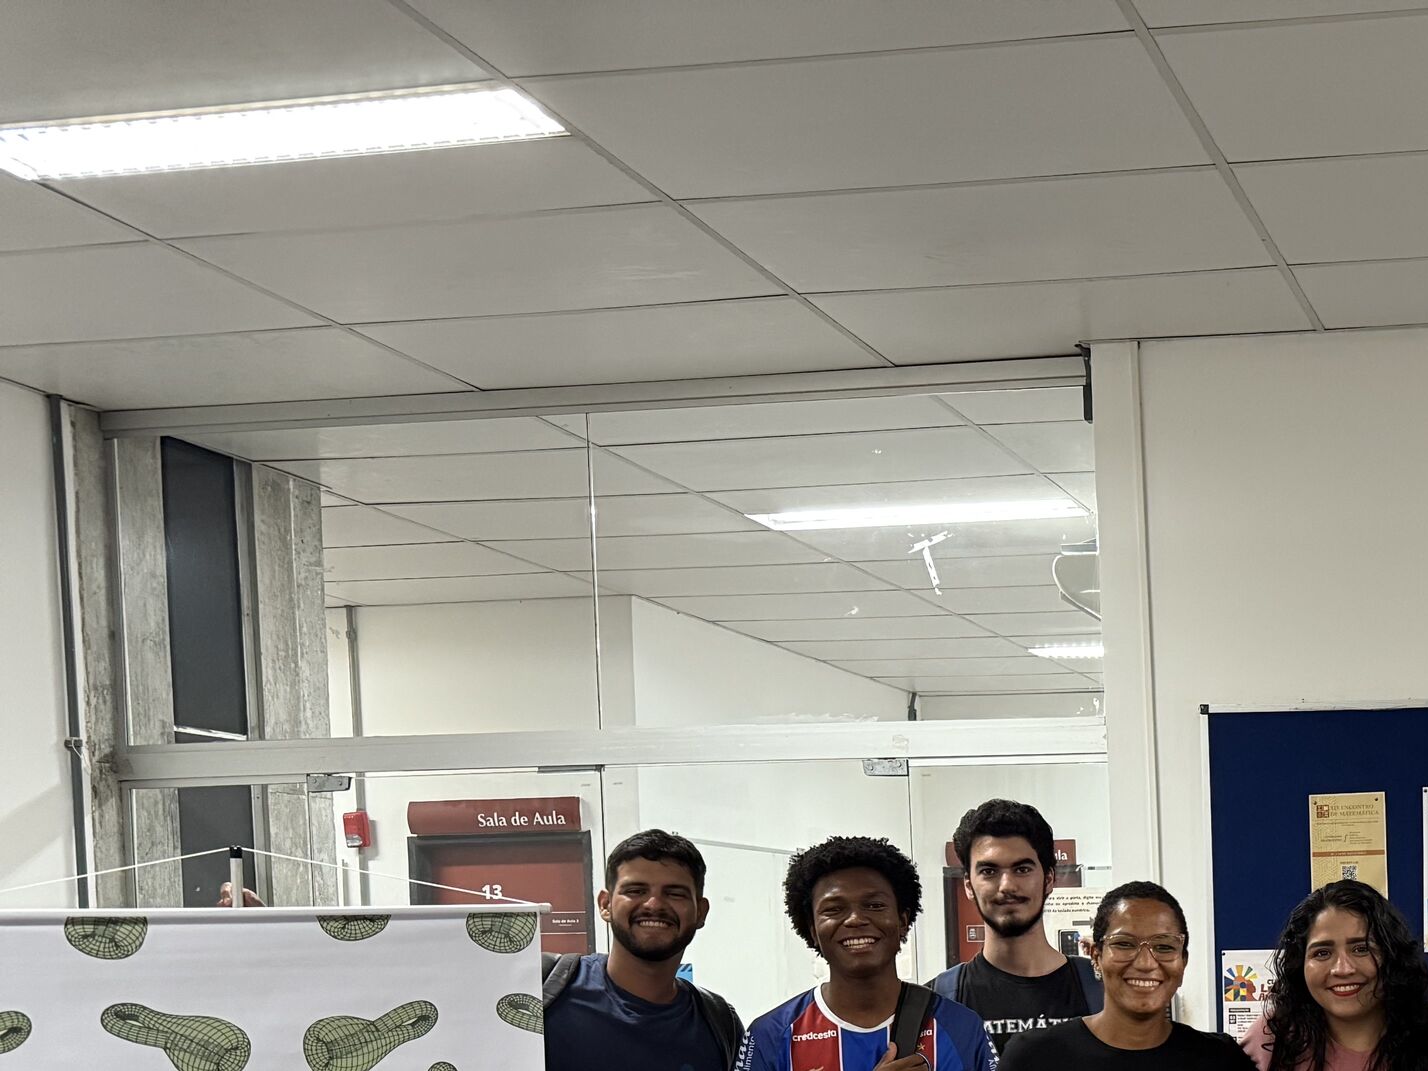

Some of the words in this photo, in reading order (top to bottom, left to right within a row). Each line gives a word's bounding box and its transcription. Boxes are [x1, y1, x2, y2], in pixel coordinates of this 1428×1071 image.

[478, 813, 507, 828] Sala
[511, 812, 529, 826] de
[533, 811, 566, 826] Aula
[1055, 850, 1068, 861] la
[482, 884, 502, 899] 13
[792, 1029, 837, 1042] credcesta
